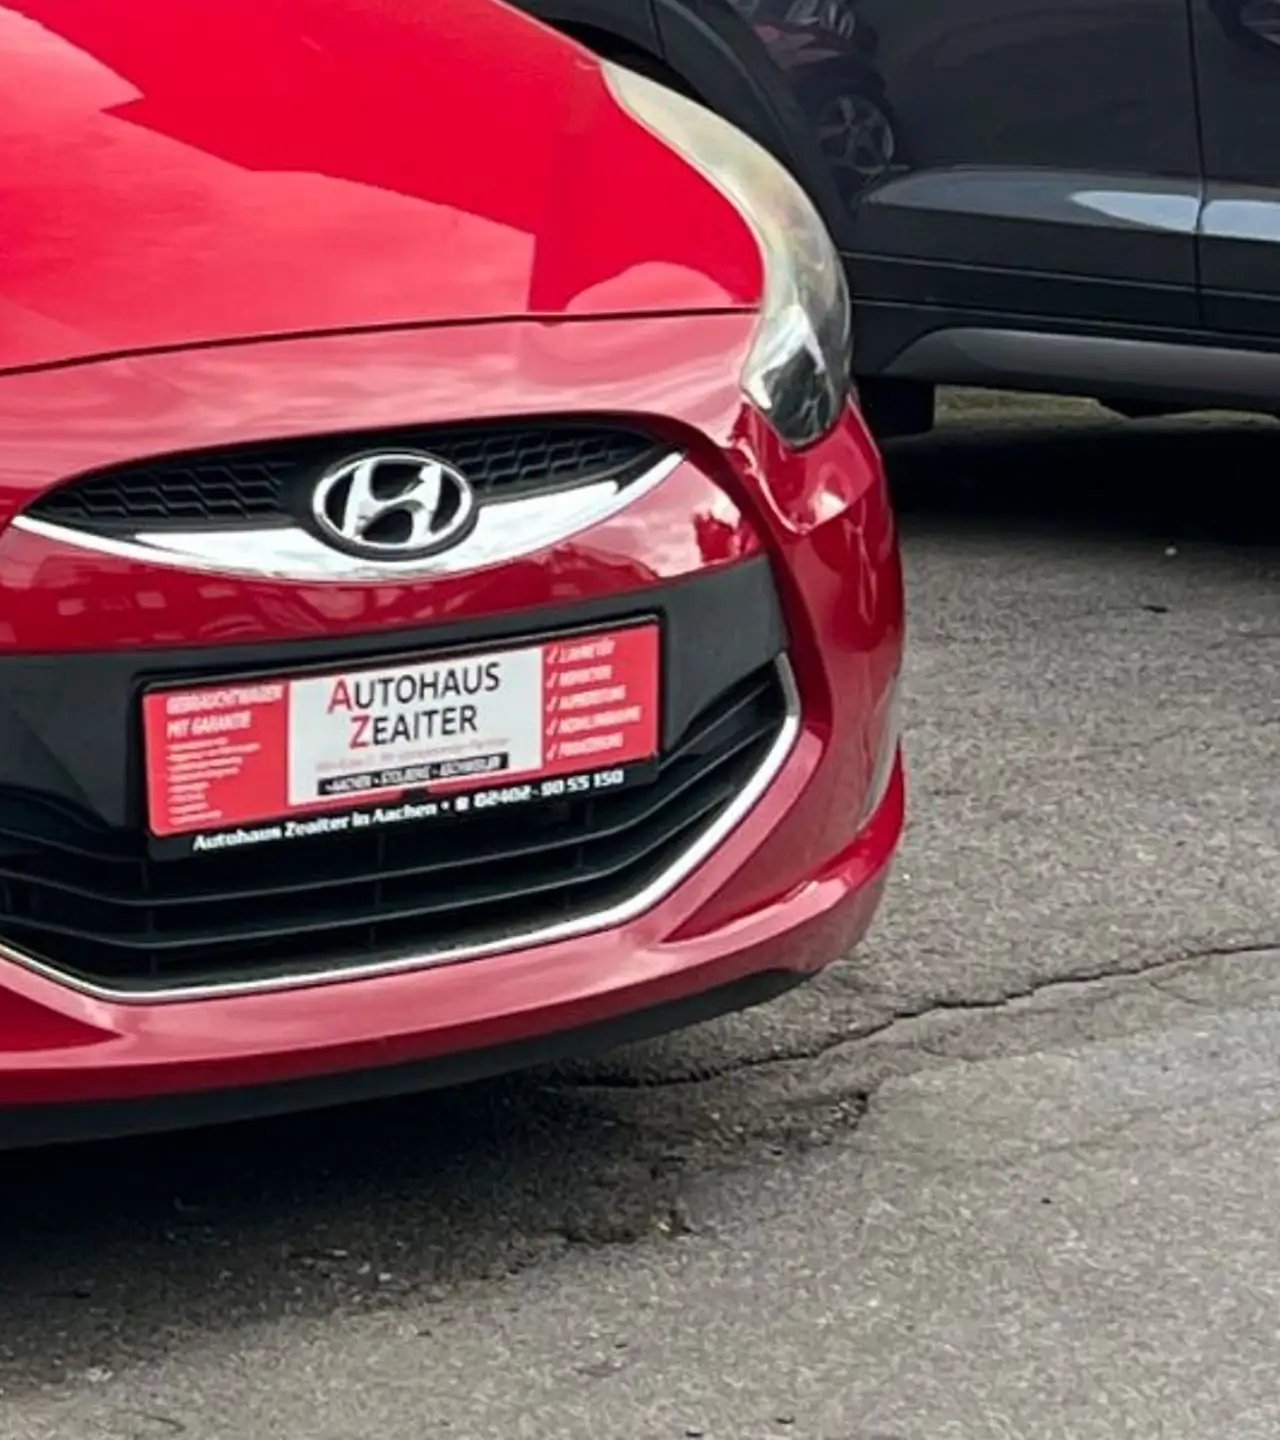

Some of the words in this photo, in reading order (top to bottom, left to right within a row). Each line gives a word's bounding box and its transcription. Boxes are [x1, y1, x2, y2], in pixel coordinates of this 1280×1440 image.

[327, 662, 500, 714] AUTOHAUS
[349, 705, 478, 750] ZEAITER
[193, 825, 281, 850] Autohaus
[285, 815, 350, 838] Zeaiter
[352, 812, 369, 827] in
[373, 802, 437, 823] Aachen
[594, 769, 624, 788] 150
